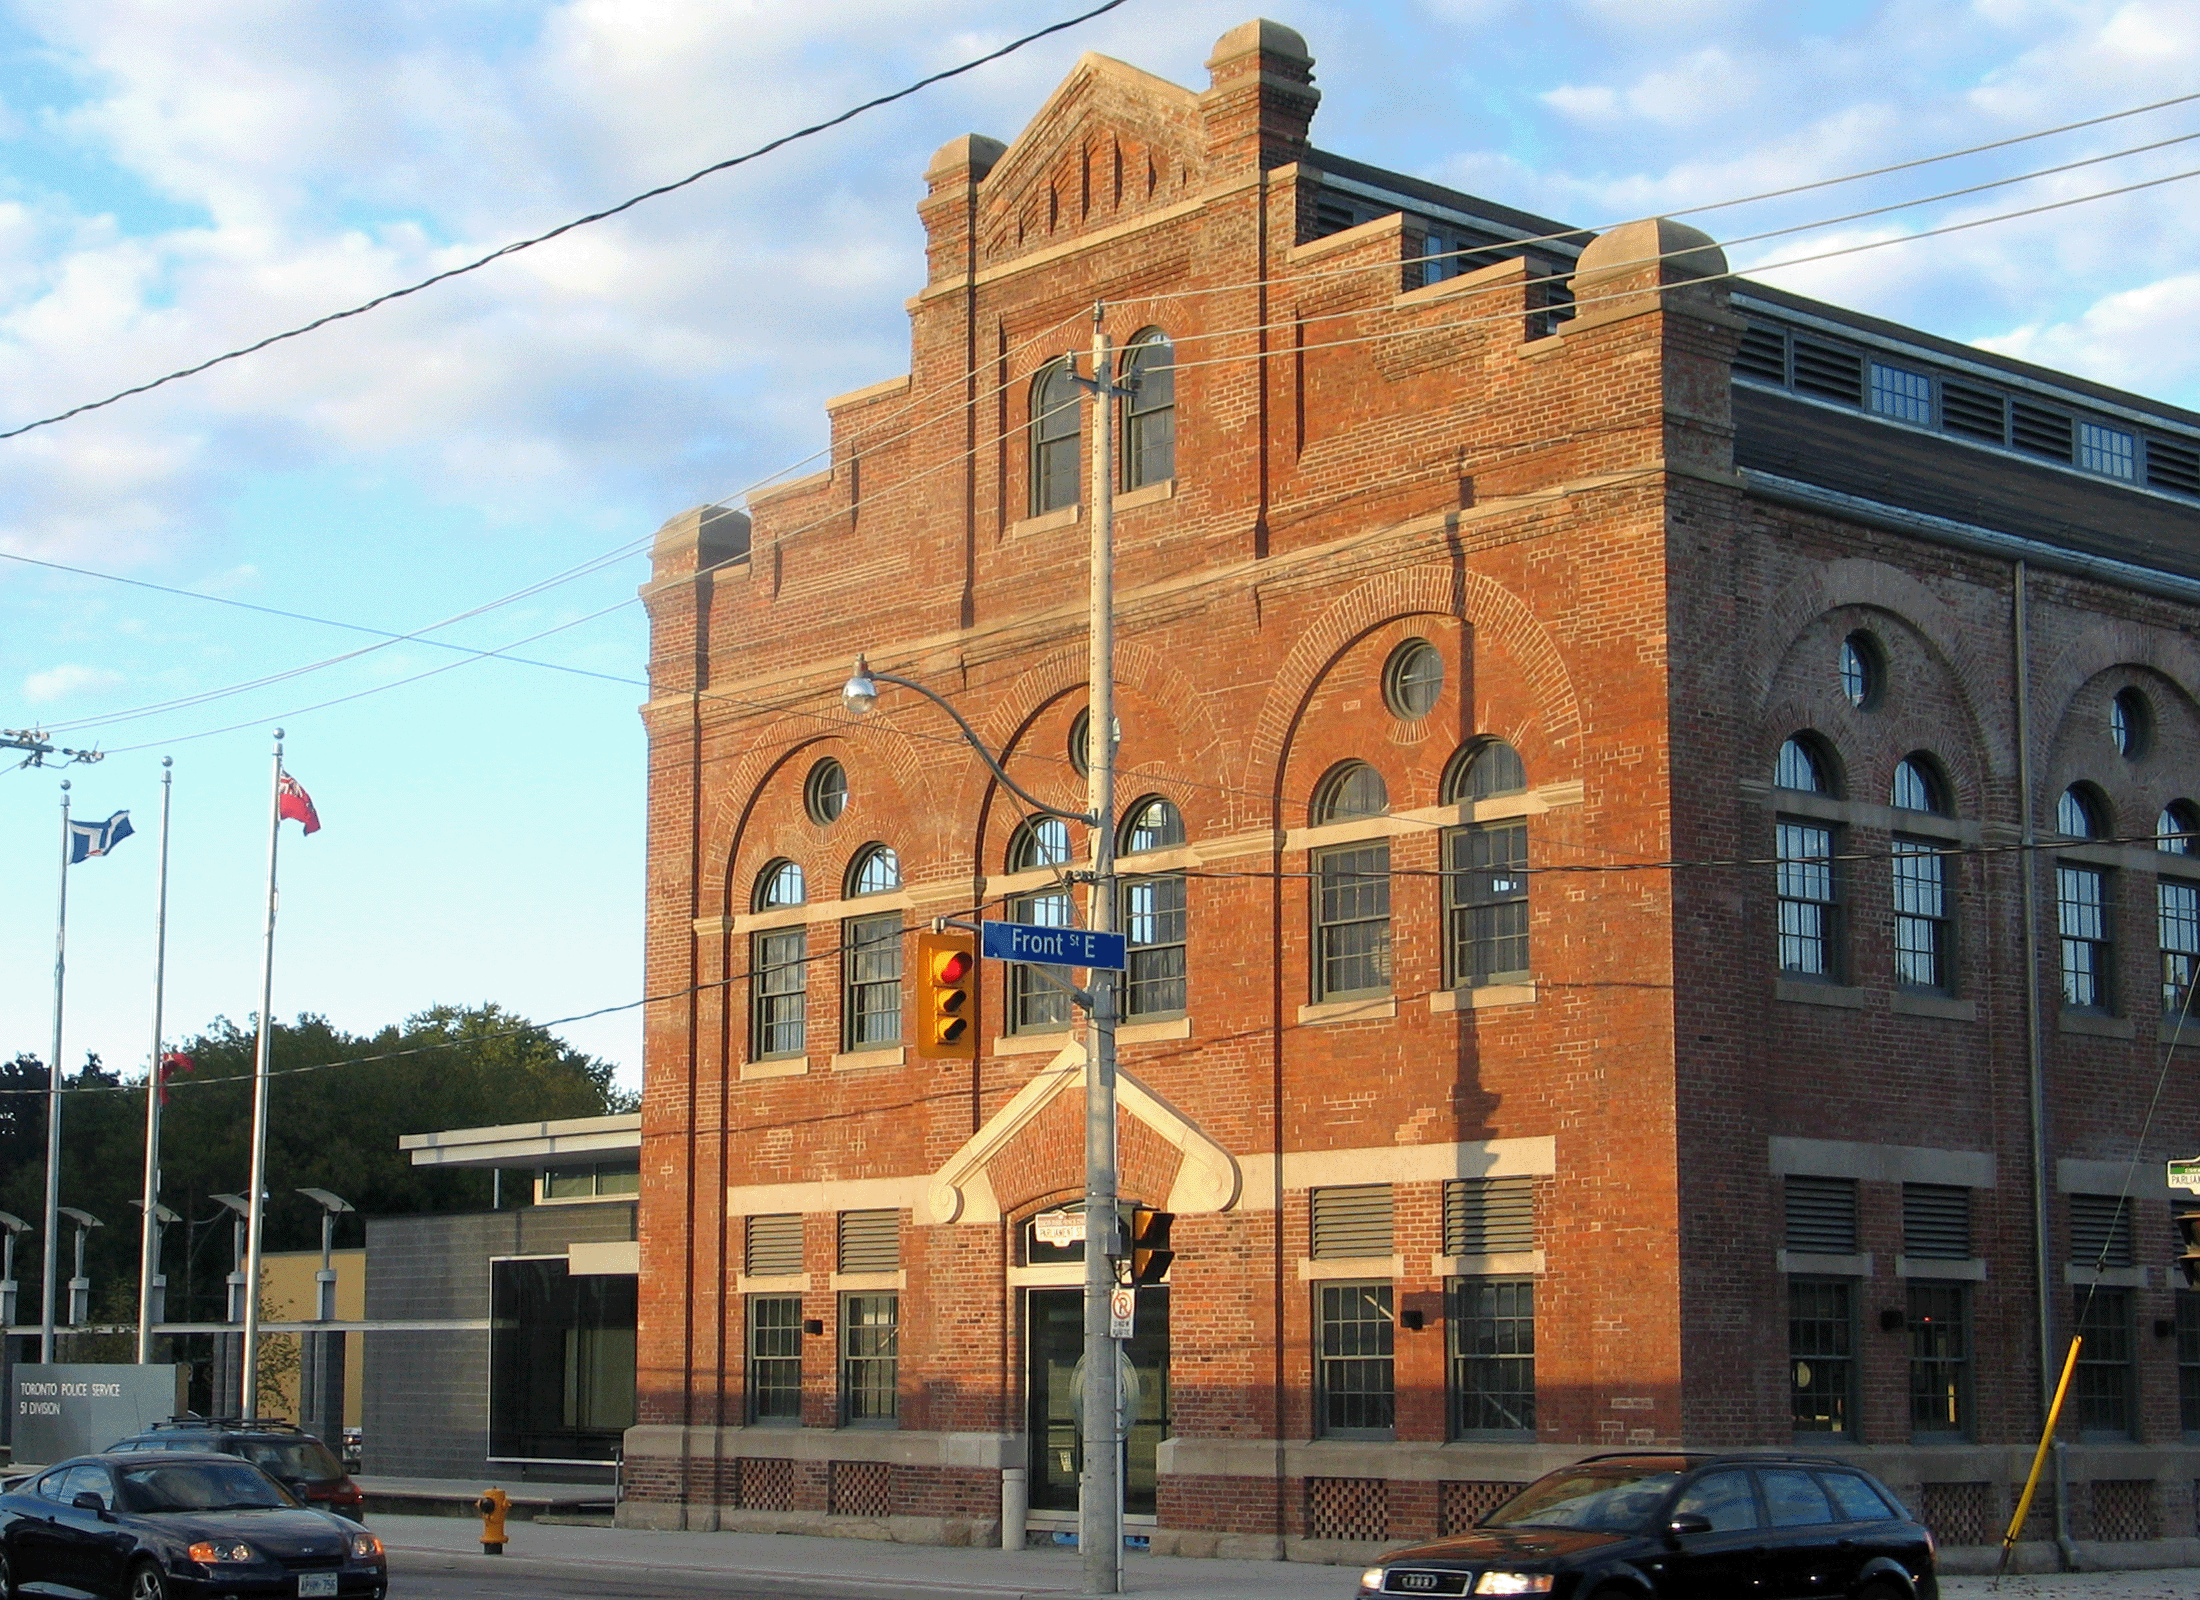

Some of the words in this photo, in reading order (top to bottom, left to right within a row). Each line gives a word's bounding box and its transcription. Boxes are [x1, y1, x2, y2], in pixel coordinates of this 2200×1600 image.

[1012, 928, 1064, 956] Front
[1069, 934, 1080, 947] St
[1085, 935, 1096, 958] E
[20, 1382, 57, 1396] TORONTO
[61, 1383, 87, 1396] POLICE
[92, 1383, 120, 1397] SERVICE
[20, 1401, 27, 1415] 51
[29, 1401, 60, 1415] DIVISION
